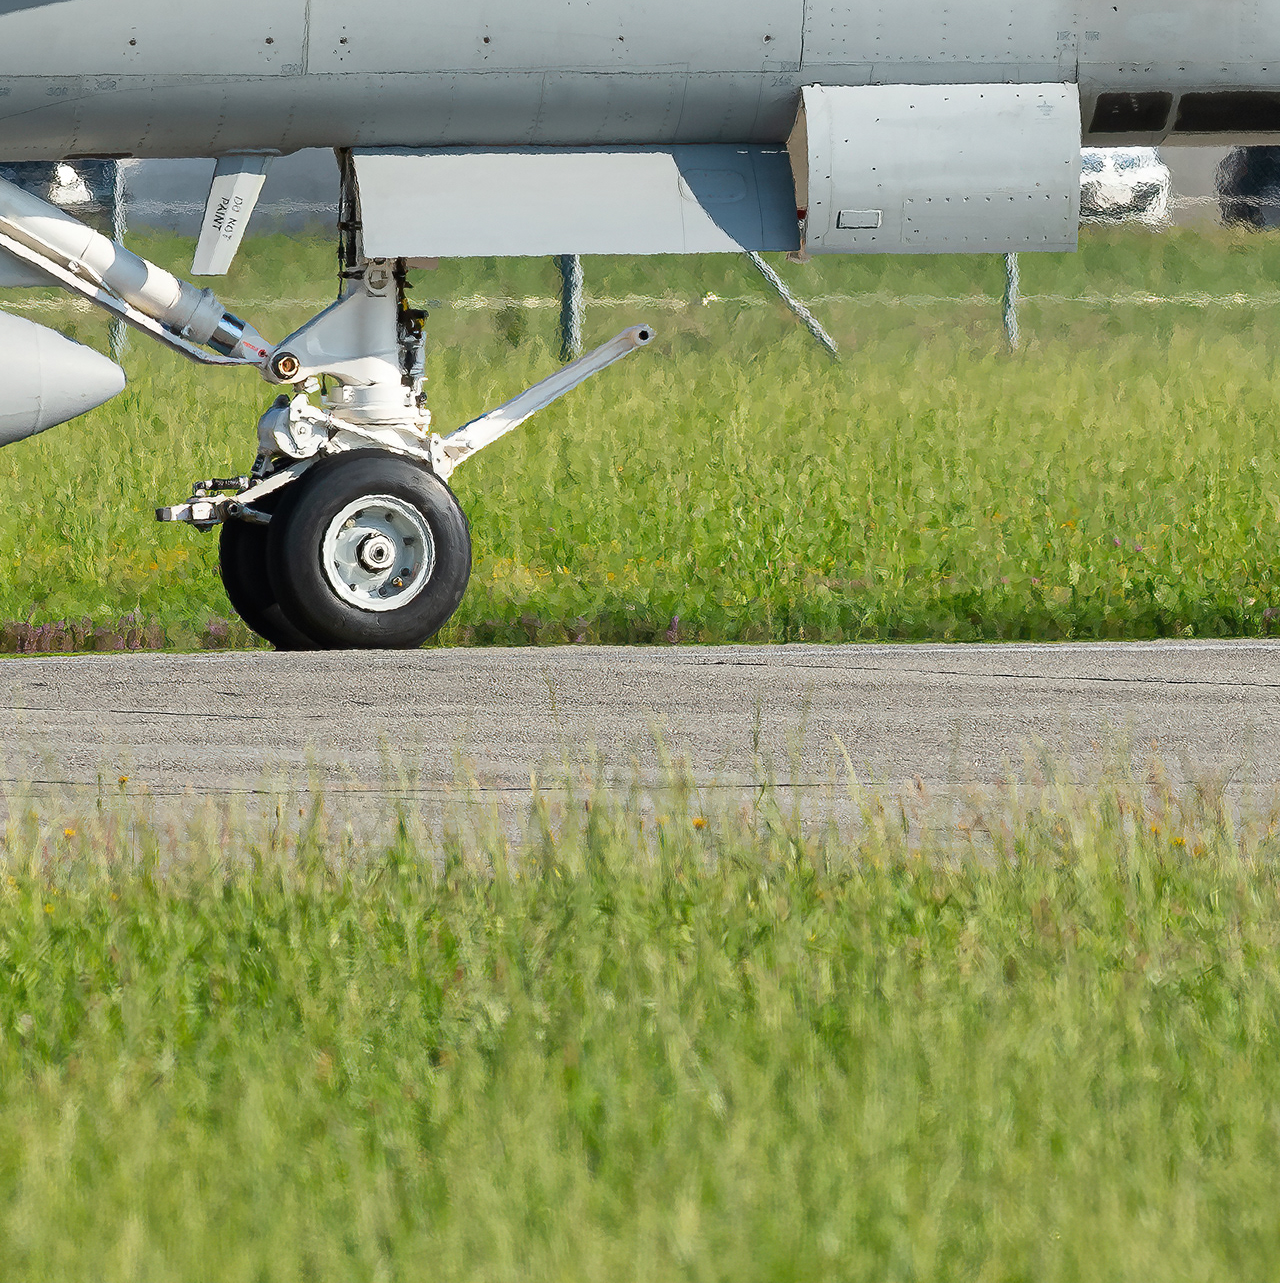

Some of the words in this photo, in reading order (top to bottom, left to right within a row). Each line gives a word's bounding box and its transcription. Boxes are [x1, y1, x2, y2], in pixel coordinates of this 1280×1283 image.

[212, 196, 231, 232] PAINT
[231, 196, 244, 213] DO
[222, 217, 238, 241] NOT
